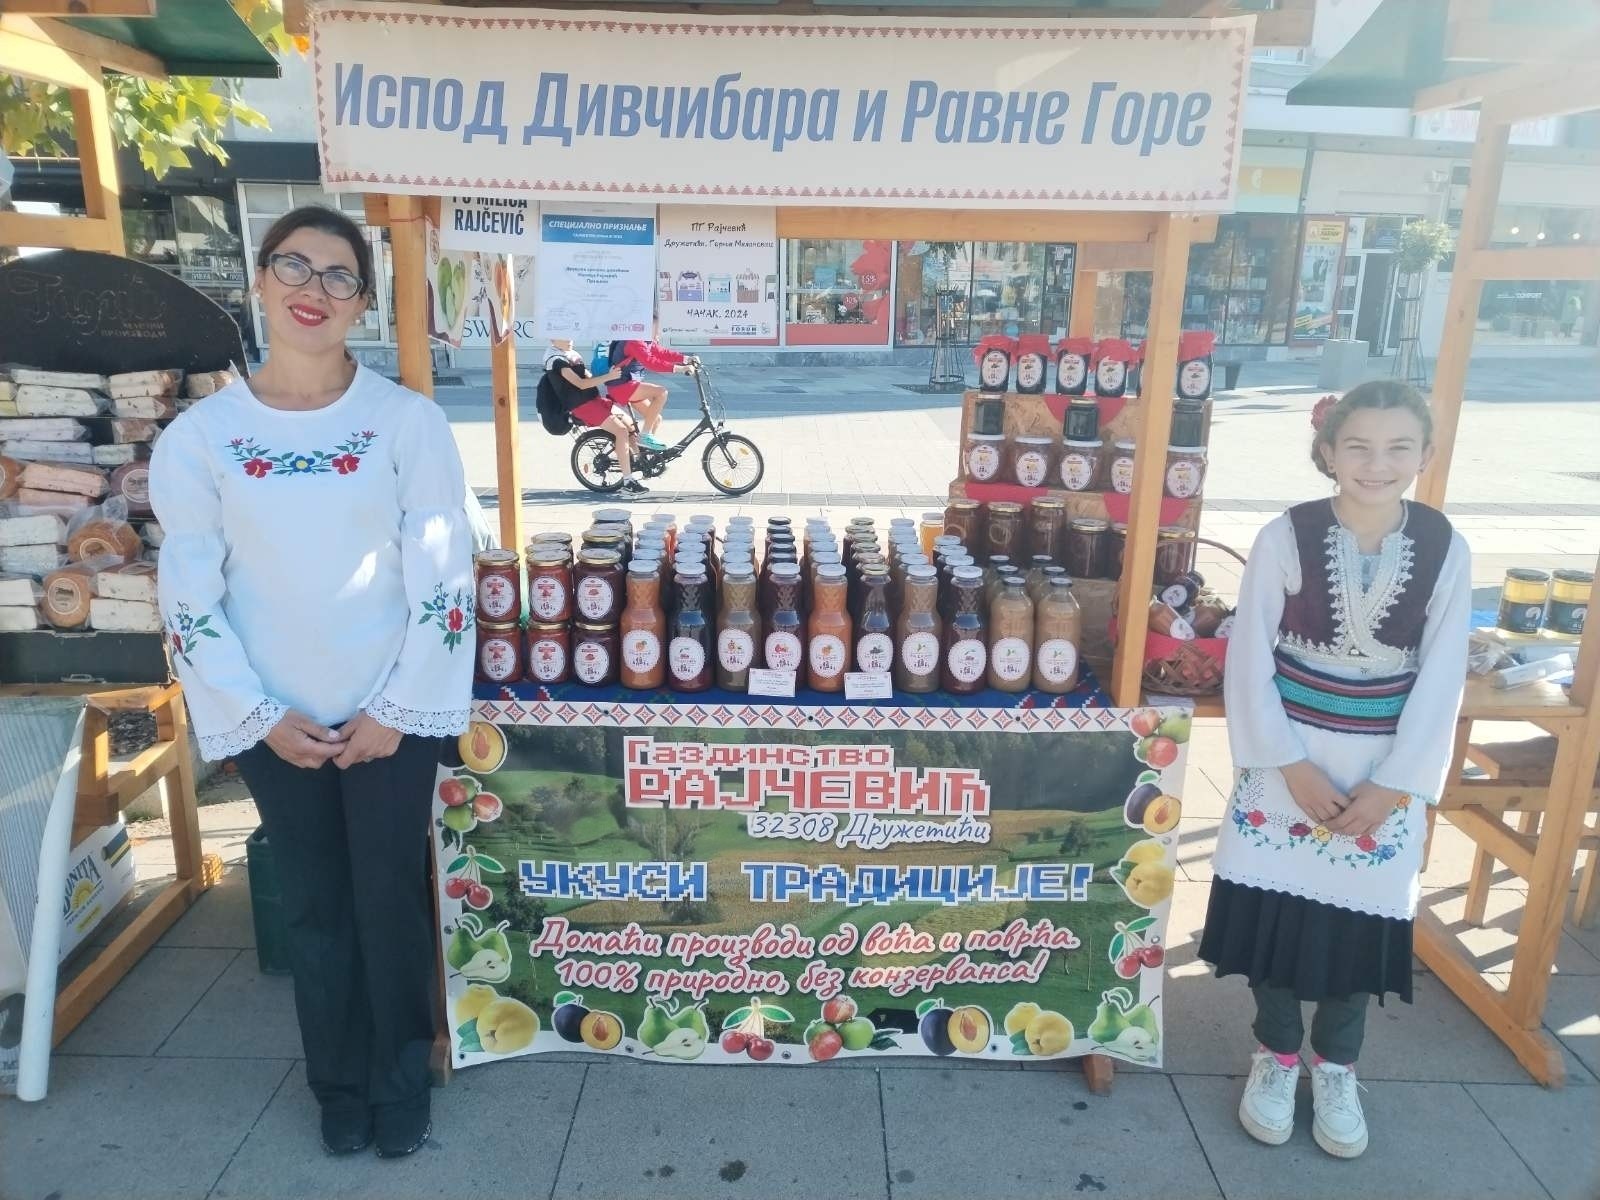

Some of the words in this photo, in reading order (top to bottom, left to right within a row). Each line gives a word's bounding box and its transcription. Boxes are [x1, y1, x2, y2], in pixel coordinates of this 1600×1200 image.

[335, 62, 508, 145] Испод
[523, 71, 840, 152] Дивчибара
[853, 89, 888, 142] и
[901, 80, 1070, 145] Равне
[1081, 81, 1212, 157] Горе
[453, 207, 525, 236] RAJČEVIĆ
[548, 220, 602, 230] СПЕЦИЈАЛНО
[603, 222, 648, 232] ПРИЗНАЊЕ
[724, 308, 749, 319] 2024
[627, 739, 890, 767] Газдинство
[627, 767, 987, 812] РАЈЧЕВИЋ
[752, 813, 836, 838] 32308
[842, 814, 989, 845] Дружетићи
[519, 862, 707, 901] УКУСИ
[743, 863, 1092, 905] ТРАДИЦИЈЕ!
[532, 920, 659, 957] Домаћи
[670, 926, 812, 963] производи
[822, 925, 857, 955] од
[862, 923, 935, 953] воћа
[940, 930, 961, 952] и
[559, 960, 639, 992] 100%
[647, 960, 787, 996] природно,
[801, 963, 842, 999] без
[852, 952, 1046, 994] конзерванса!
